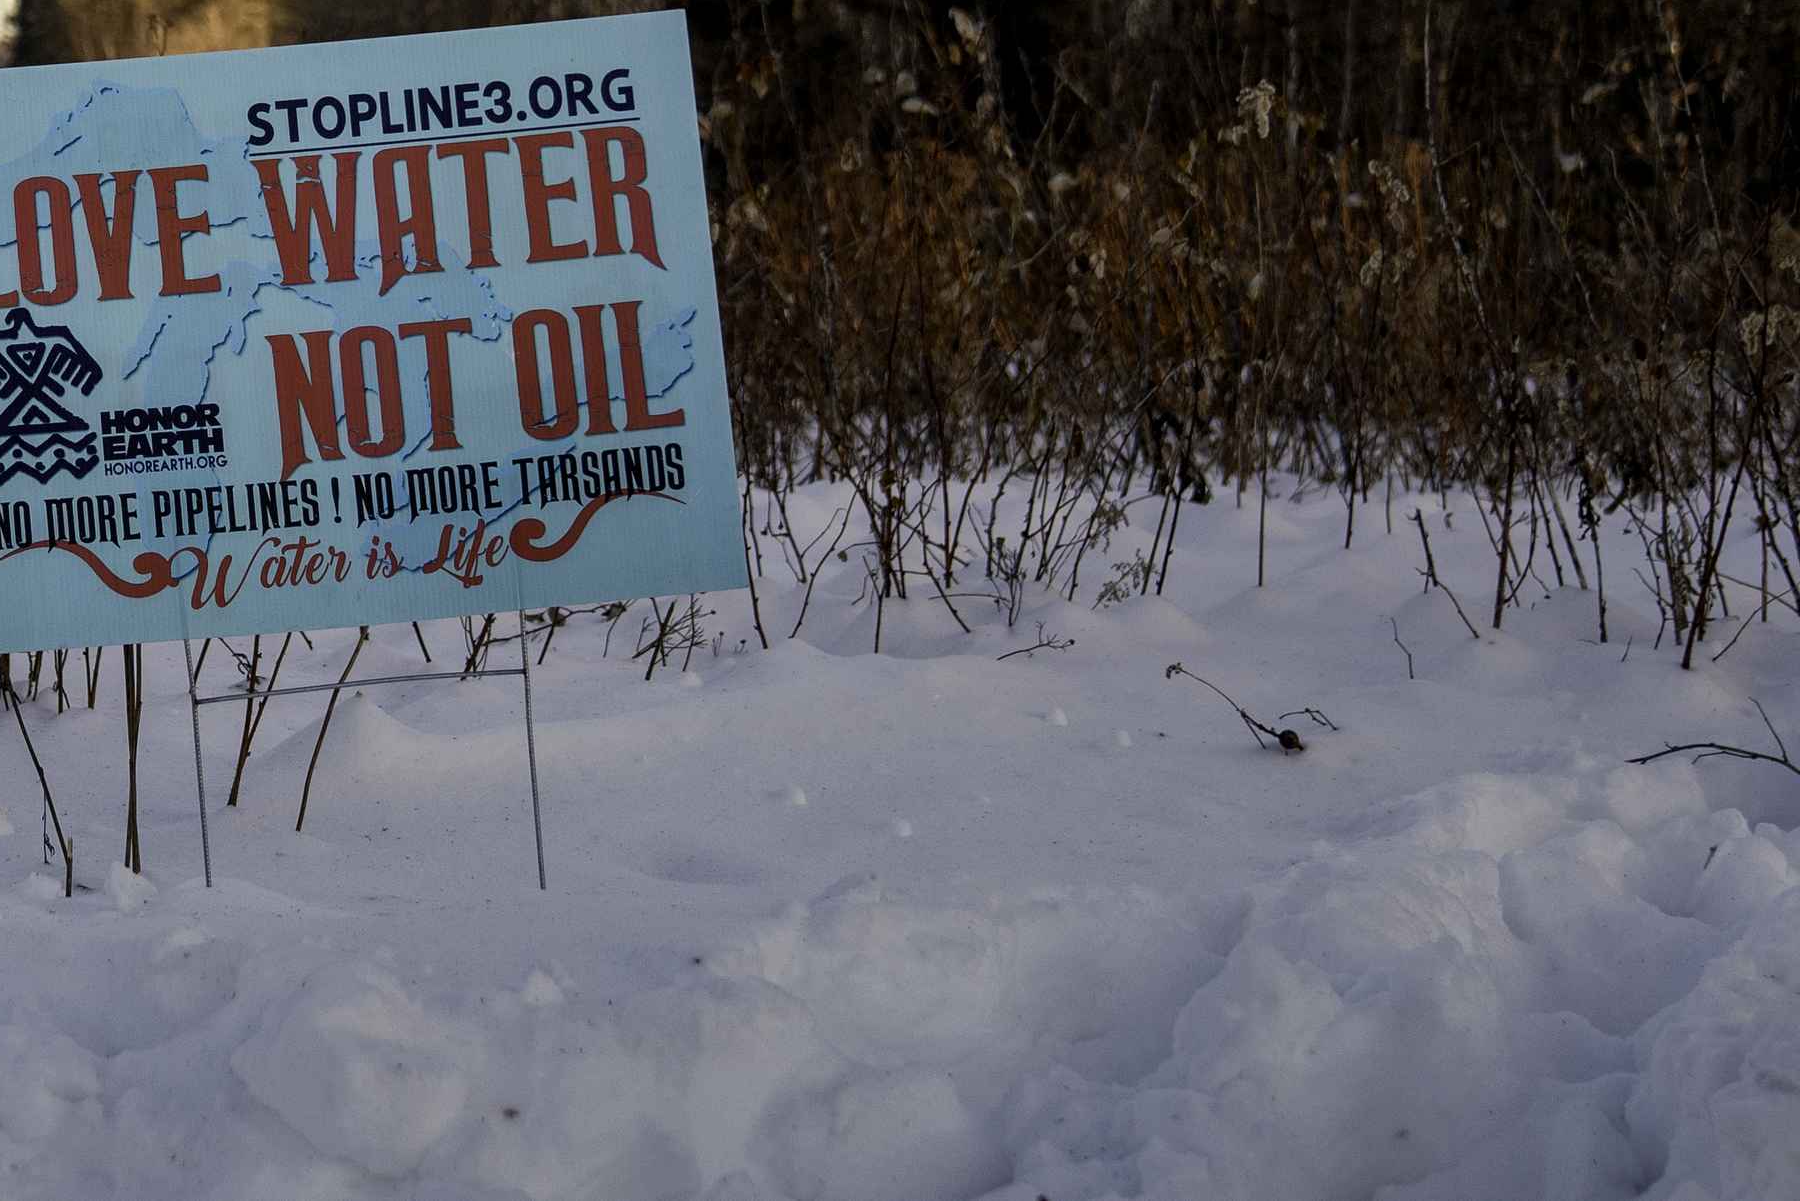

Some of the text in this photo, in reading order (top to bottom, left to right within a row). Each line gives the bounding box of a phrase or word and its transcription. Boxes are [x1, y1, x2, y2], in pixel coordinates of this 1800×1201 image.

[246, 67, 637, 147] STOPLINE3.ORG
[251, 126, 668, 296] WATER
[100, 403, 222, 435] HONOR
[265, 300, 686, 482] NOT OIL
[102, 428, 225, 462] EARTH
[104, 454, 229, 477] HONOREARTH.ORG
[44, 492, 142, 554] MORE
[352, 471, 396, 529] NO
[405, 460, 502, 526] MORE
[511, 442, 686, 510] TARSANDS
[169, 518, 509, 611] Water is Life
